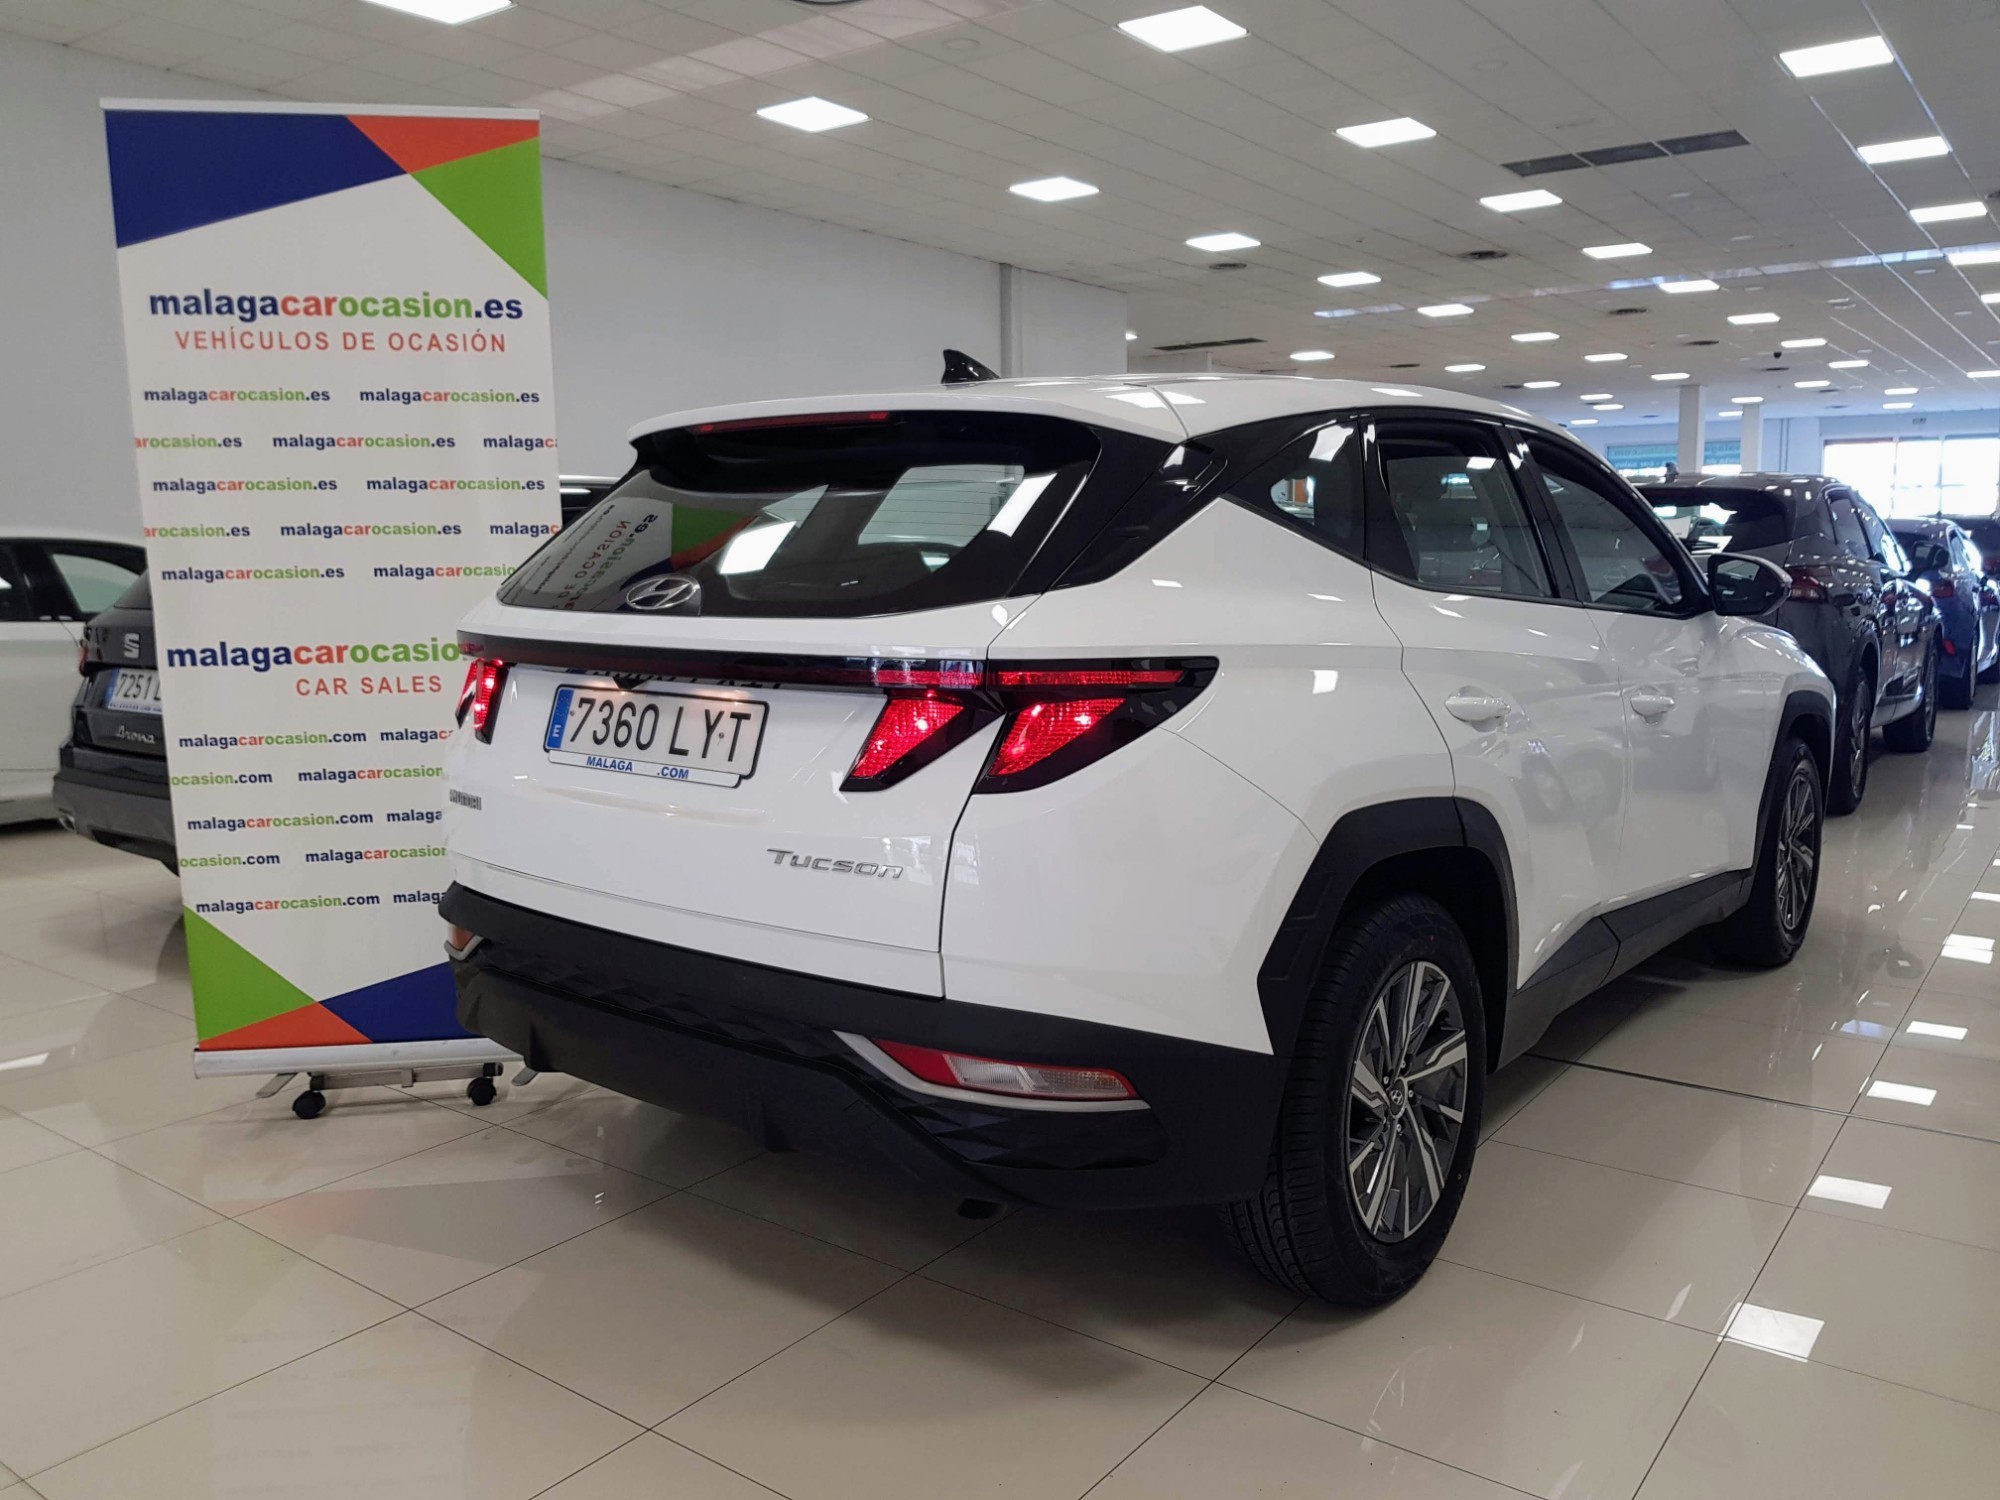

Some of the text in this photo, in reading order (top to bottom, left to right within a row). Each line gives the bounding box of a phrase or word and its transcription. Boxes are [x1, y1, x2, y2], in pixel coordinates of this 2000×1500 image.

[150, 288, 523, 323] malagacarocasion.es
[176, 327, 504, 352] VEHÍCULOS DE OCASIÓN
[144, 388, 539, 405] malagacarocasion.es malagacarocasion.es
[273, 434, 455, 451] malagacarocasion.es
[153, 477, 545, 494] malagacarocasion.es malagacarocasion.es
[281, 522, 461, 539] malagacarocasion.es
[162, 566, 344, 583] malagacarocasion.es
[115, 672, 153, 701] 7251
[296, 676, 441, 696] CAR SALES
[552, 697, 752, 763] E 7360 LYT
[179, 732, 366, 749] malagacarocasion.com
[586, 755, 690, 780] MALAGA .COM
[171, 772, 272, 786] ocasion.com
[187, 814, 373, 831] malagacarocasion.com
[180, 853, 281, 868] ocasion.com
[196, 893, 380, 914] malagacarocasion.com
